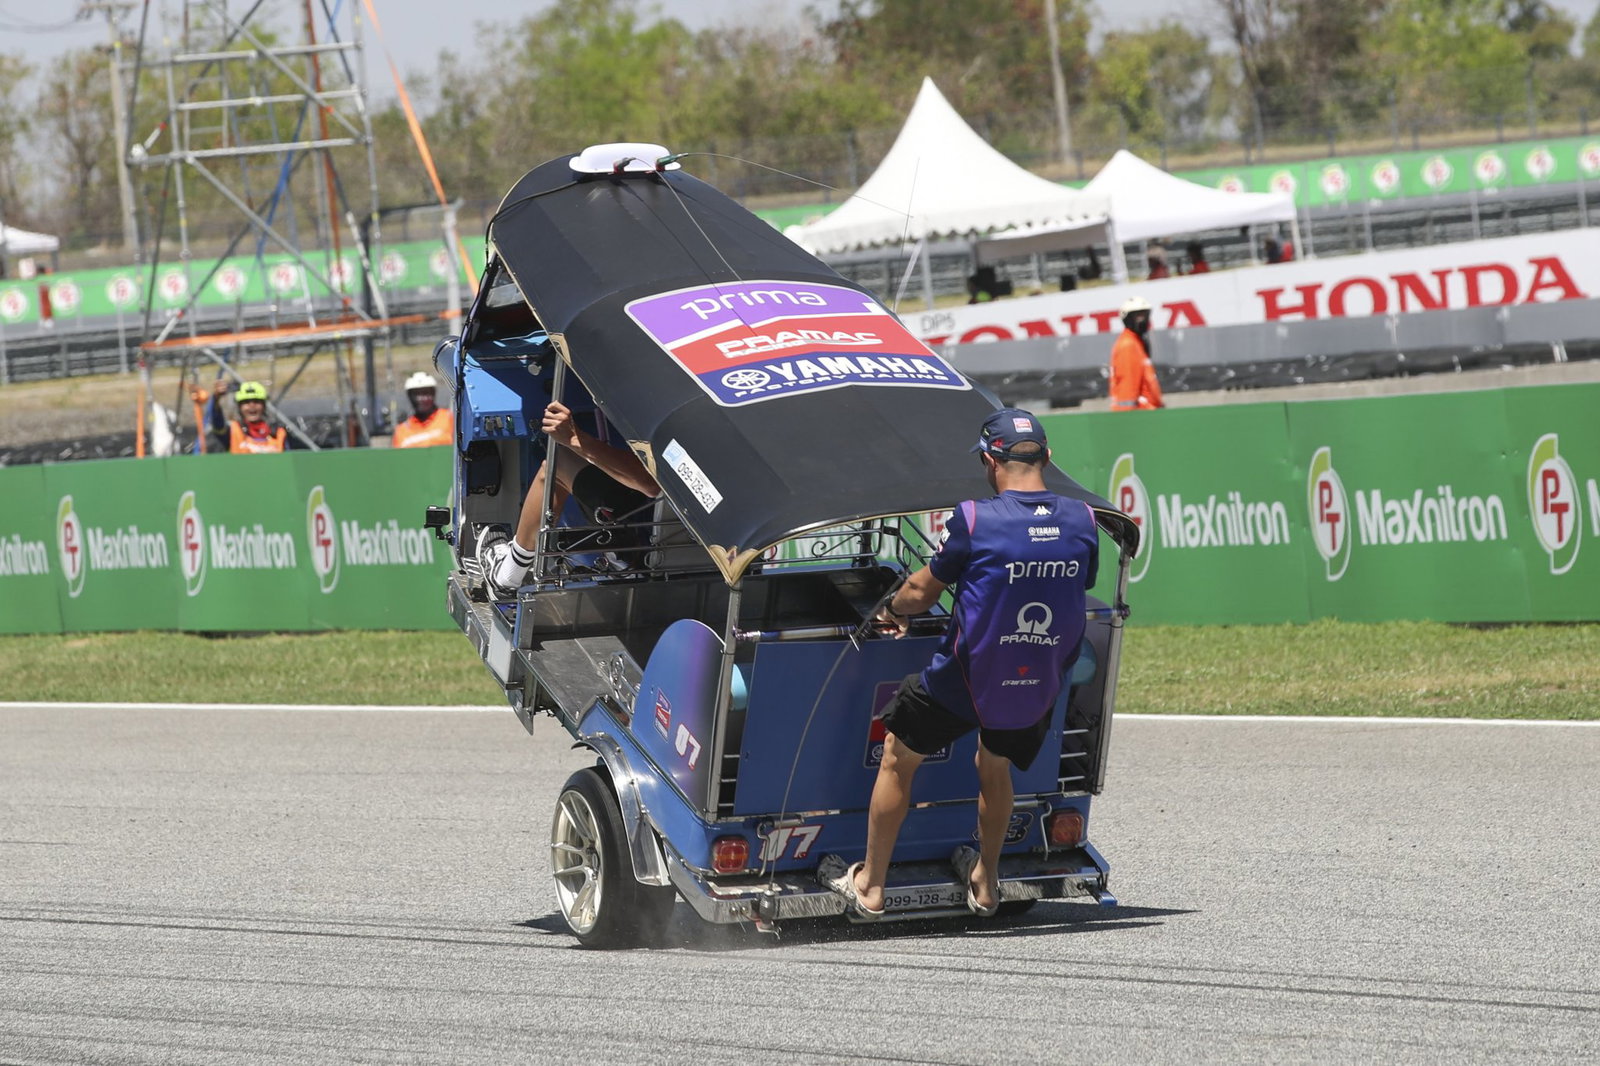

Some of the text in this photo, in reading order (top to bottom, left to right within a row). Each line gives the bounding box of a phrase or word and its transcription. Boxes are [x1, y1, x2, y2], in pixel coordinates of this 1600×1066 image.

[1256, 255, 1589, 322] HONDA
[680, 290, 828, 320] prima
[715, 329, 883, 354] PRAMAC
[765, 356, 944, 381] YAMAHA
[735, 373, 949, 397] FACTORY RACING
[0, 533, 49, 576] xnitron
[1005, 561, 1079, 584] prima
[1000, 634, 1060, 646] PRAMAC
[885, 892, 967, 907] 099-128-43
